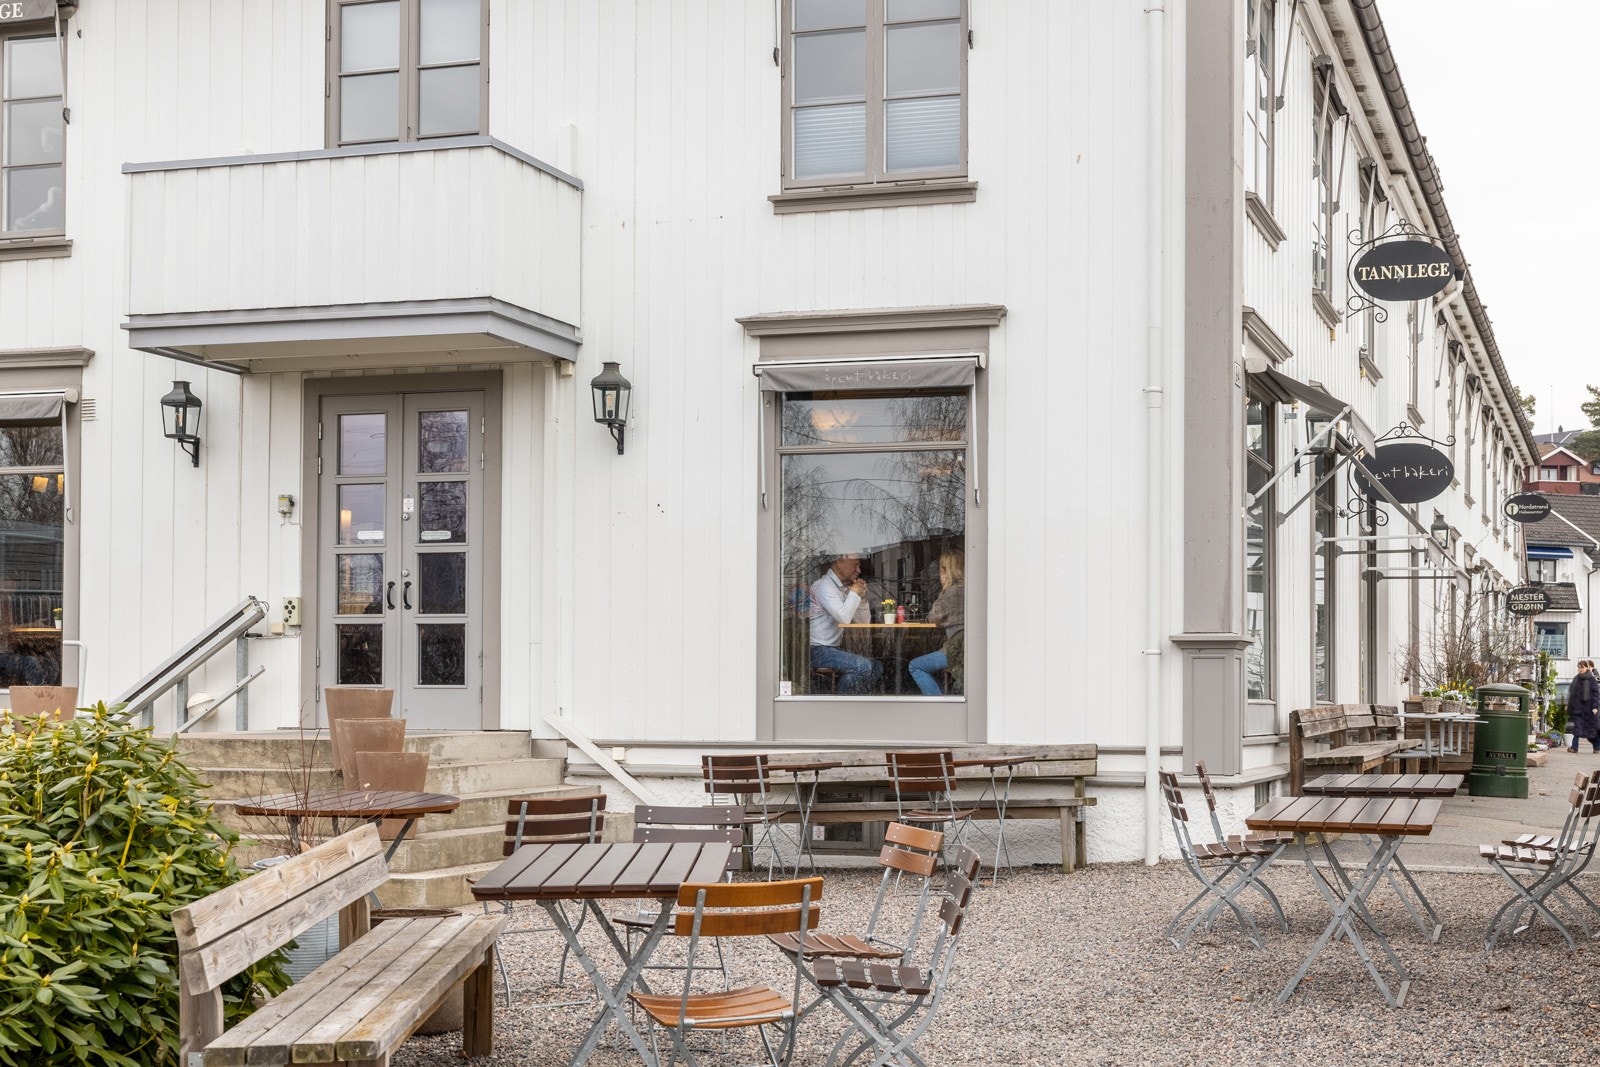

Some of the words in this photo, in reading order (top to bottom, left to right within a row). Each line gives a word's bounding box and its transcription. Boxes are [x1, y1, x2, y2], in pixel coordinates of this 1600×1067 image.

[1359, 262, 1450, 281] TANNLEGE
[868, 369, 911, 382] bakeri
[1404, 465, 1449, 479] bakeri
[1511, 593, 1545, 601] MESTER
[1511, 603, 1544, 611] GRØNN
